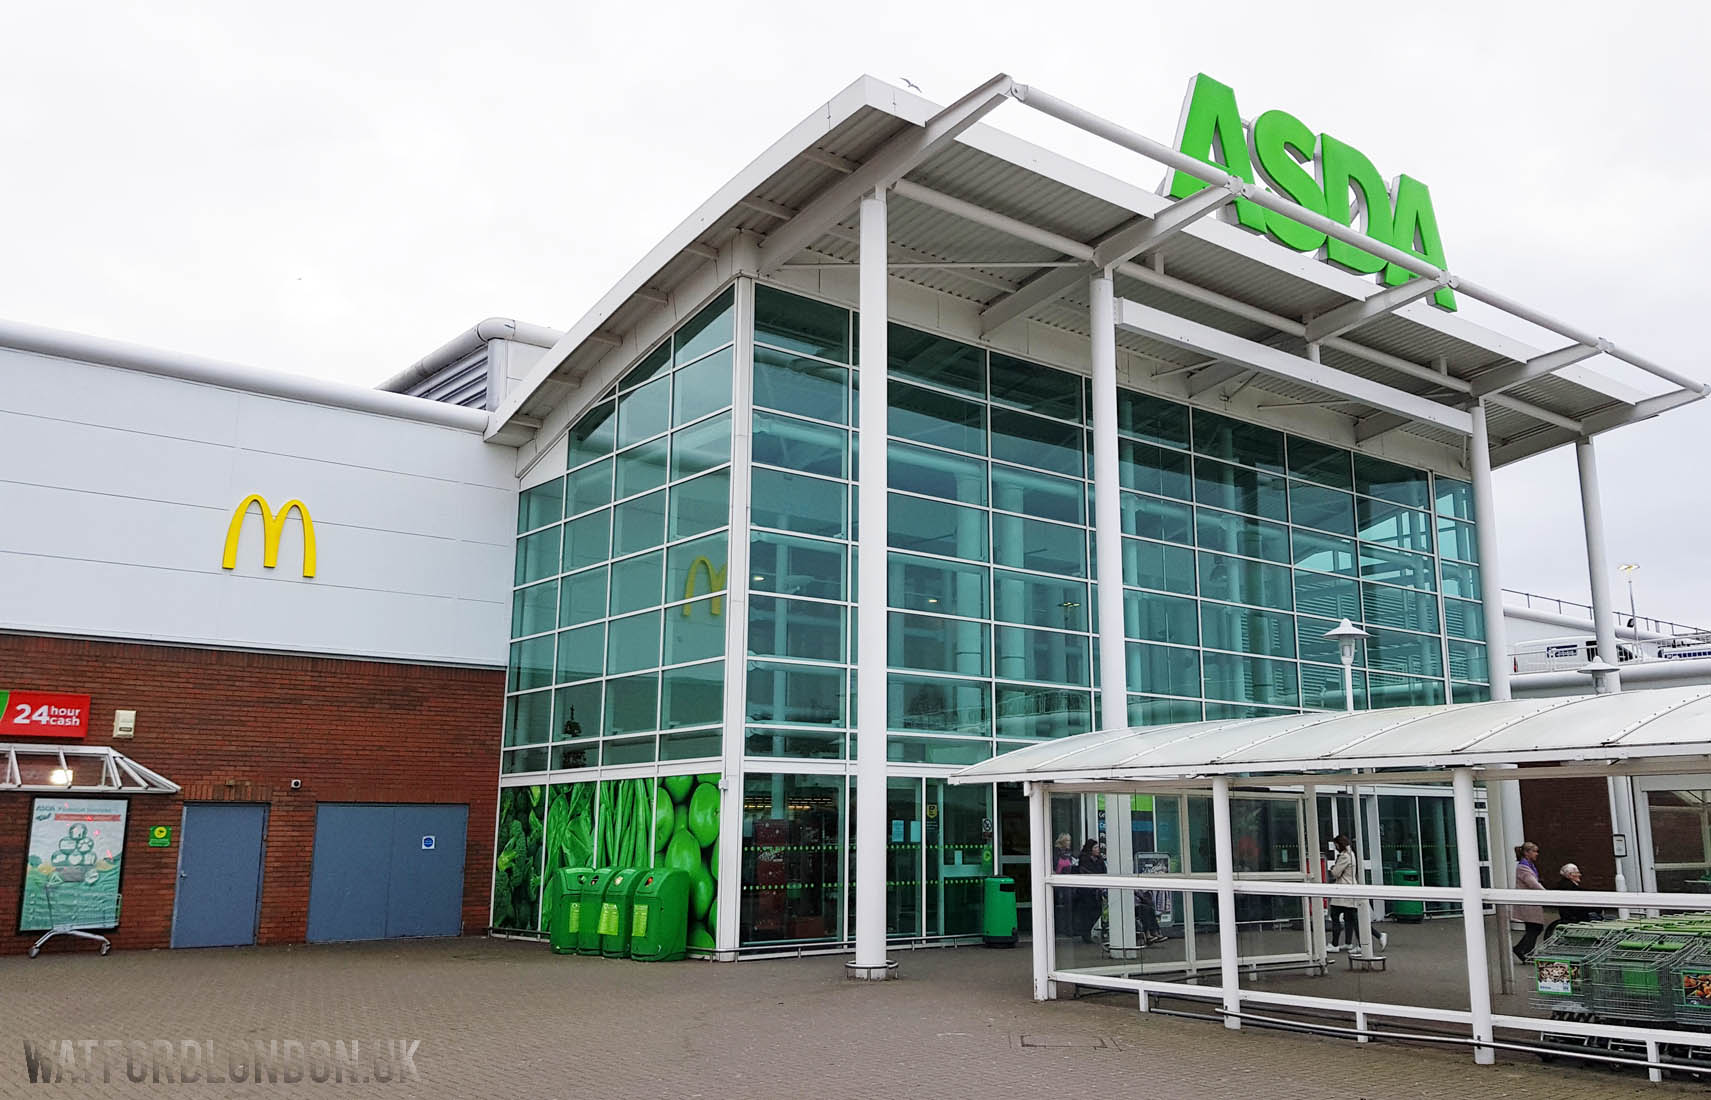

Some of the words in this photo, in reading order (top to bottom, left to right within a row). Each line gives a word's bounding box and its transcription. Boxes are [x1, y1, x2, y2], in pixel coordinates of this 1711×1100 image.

[1167, 72, 1457, 312] ASDA
[13, 703, 49, 725] 24
[50, 705, 81, 716] hour
[49, 717, 80, 726] cash
